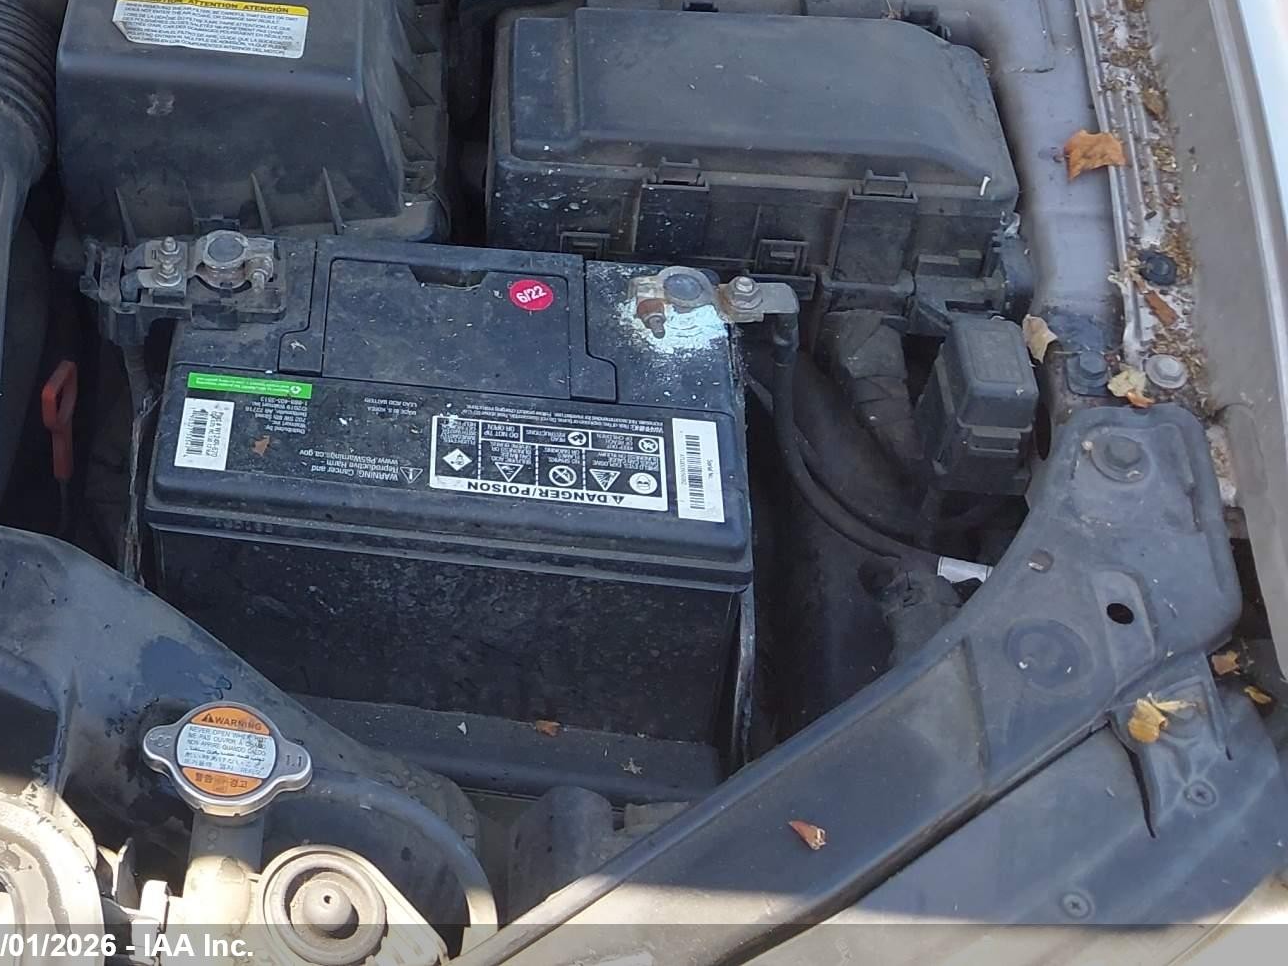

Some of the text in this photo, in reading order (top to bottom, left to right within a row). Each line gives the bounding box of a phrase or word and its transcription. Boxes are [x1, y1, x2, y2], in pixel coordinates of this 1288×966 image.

[188, 0, 238, 8] ATTENTION
[244, 4, 289, 13] ATENCIÓN
[516, 286, 547, 303] 6/22
[327, 467, 354, 476] Cancer
[349, 462, 398, 473] Reproductive
[358, 470, 398, 481] WARNING:
[216, 717, 261, 730] WARNING
